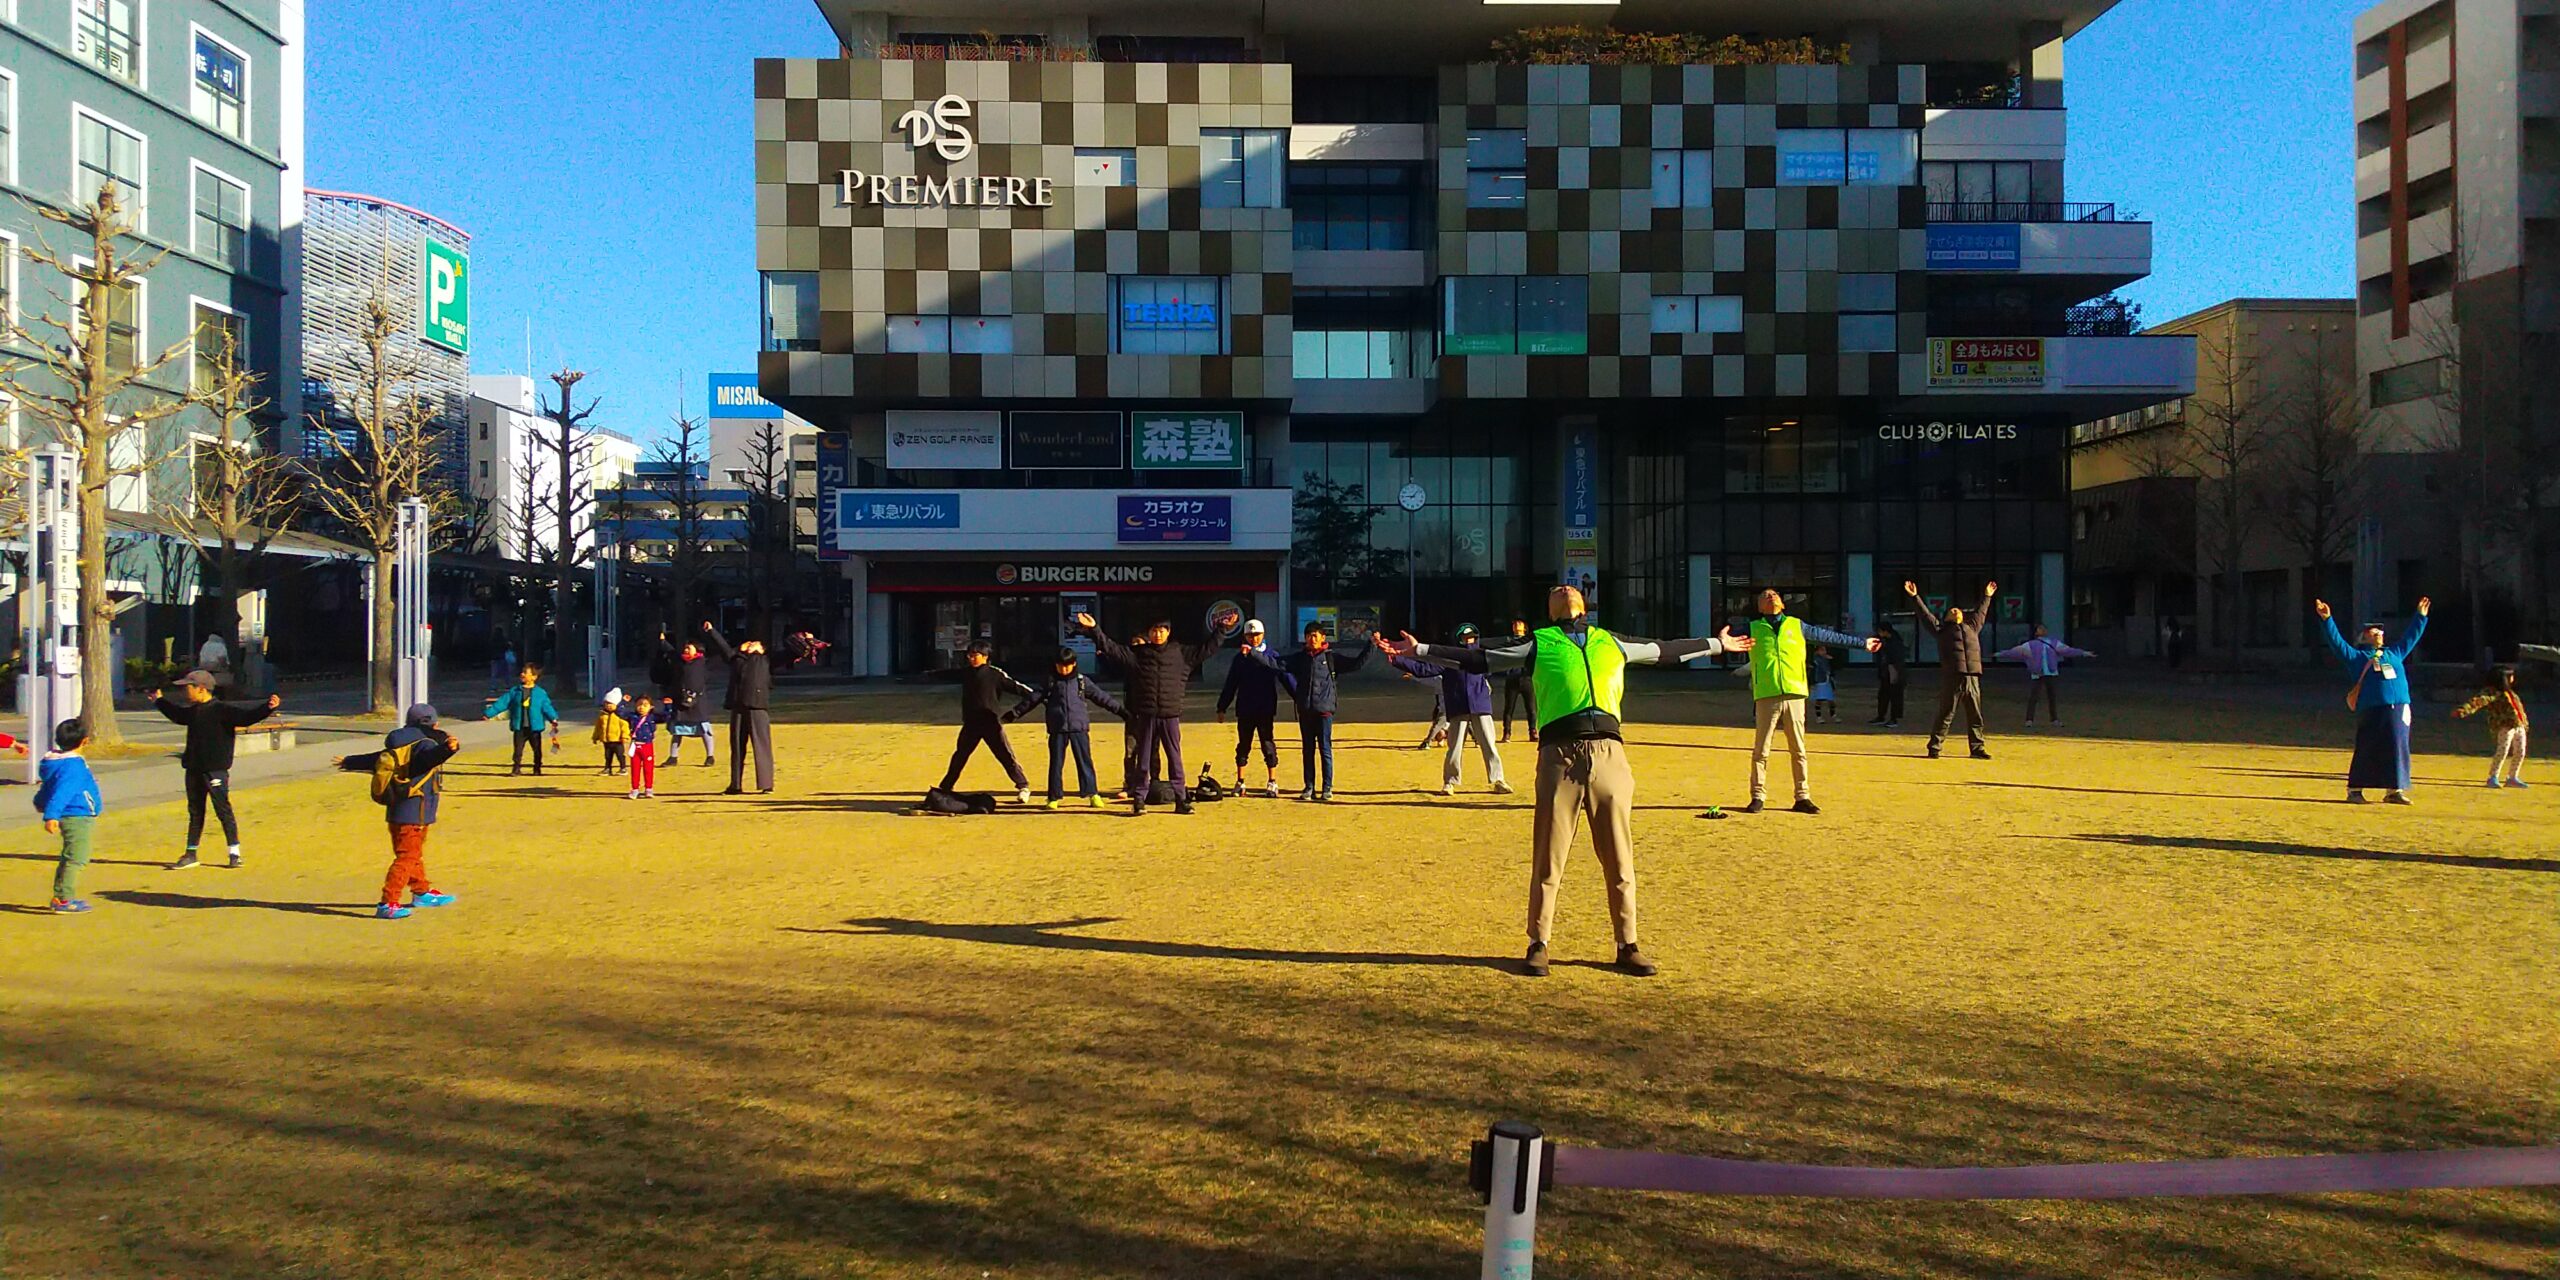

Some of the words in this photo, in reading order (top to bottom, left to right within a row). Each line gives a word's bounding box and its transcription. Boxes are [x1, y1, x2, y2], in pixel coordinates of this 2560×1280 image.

[839, 168, 1053, 209] PREMIERE
[430, 252, 456, 325] P
[1124, 303, 1216, 323] TERRA
[1955, 343, 2037, 358] 全身もみほぐし
[717, 386, 774, 406] MISAW
[906, 435, 928, 444] ZEN
[930, 435, 957, 444] GOLF
[960, 435, 995, 444] RANGE
[1142, 418, 1233, 463] 森塾
[1878, 424, 1926, 440] CLUB
[1946, 423, 2017, 440] PILATES
[871, 503, 946, 520] 東急リバブル
[1143, 500, 1205, 514] カラオケ
[1020, 565, 1100, 583] BURGER
[1103, 565, 1153, 582] KING
